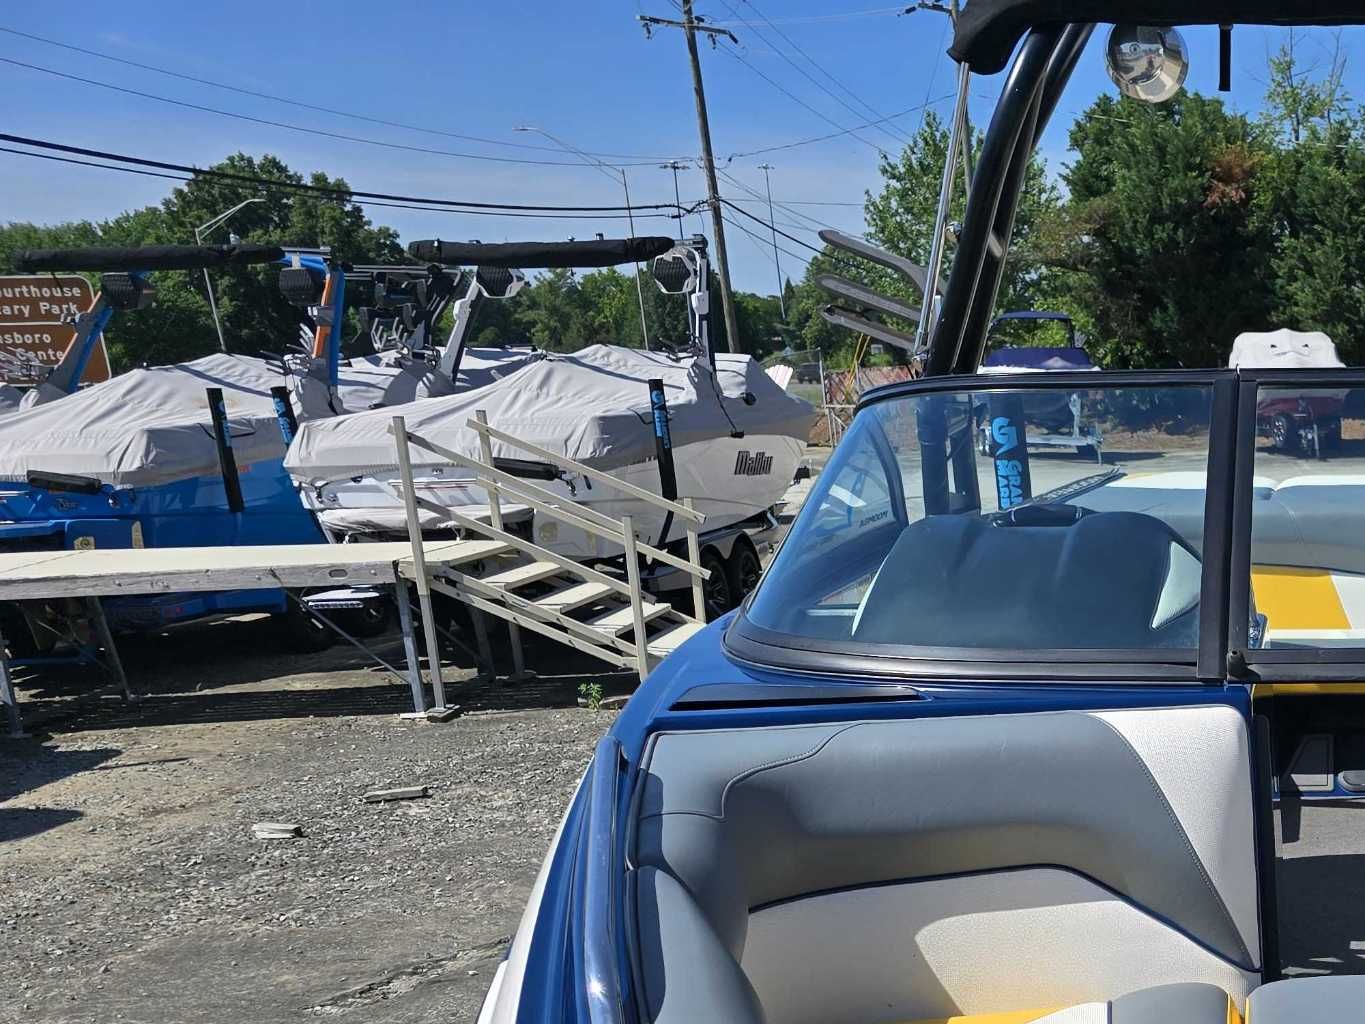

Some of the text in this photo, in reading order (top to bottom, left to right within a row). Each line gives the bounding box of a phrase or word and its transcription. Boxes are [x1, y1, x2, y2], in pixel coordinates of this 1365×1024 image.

[0, 285, 81, 298] urthouse
[0, 302, 79, 318] ary Park
[734, 450, 774, 476] Malibu
